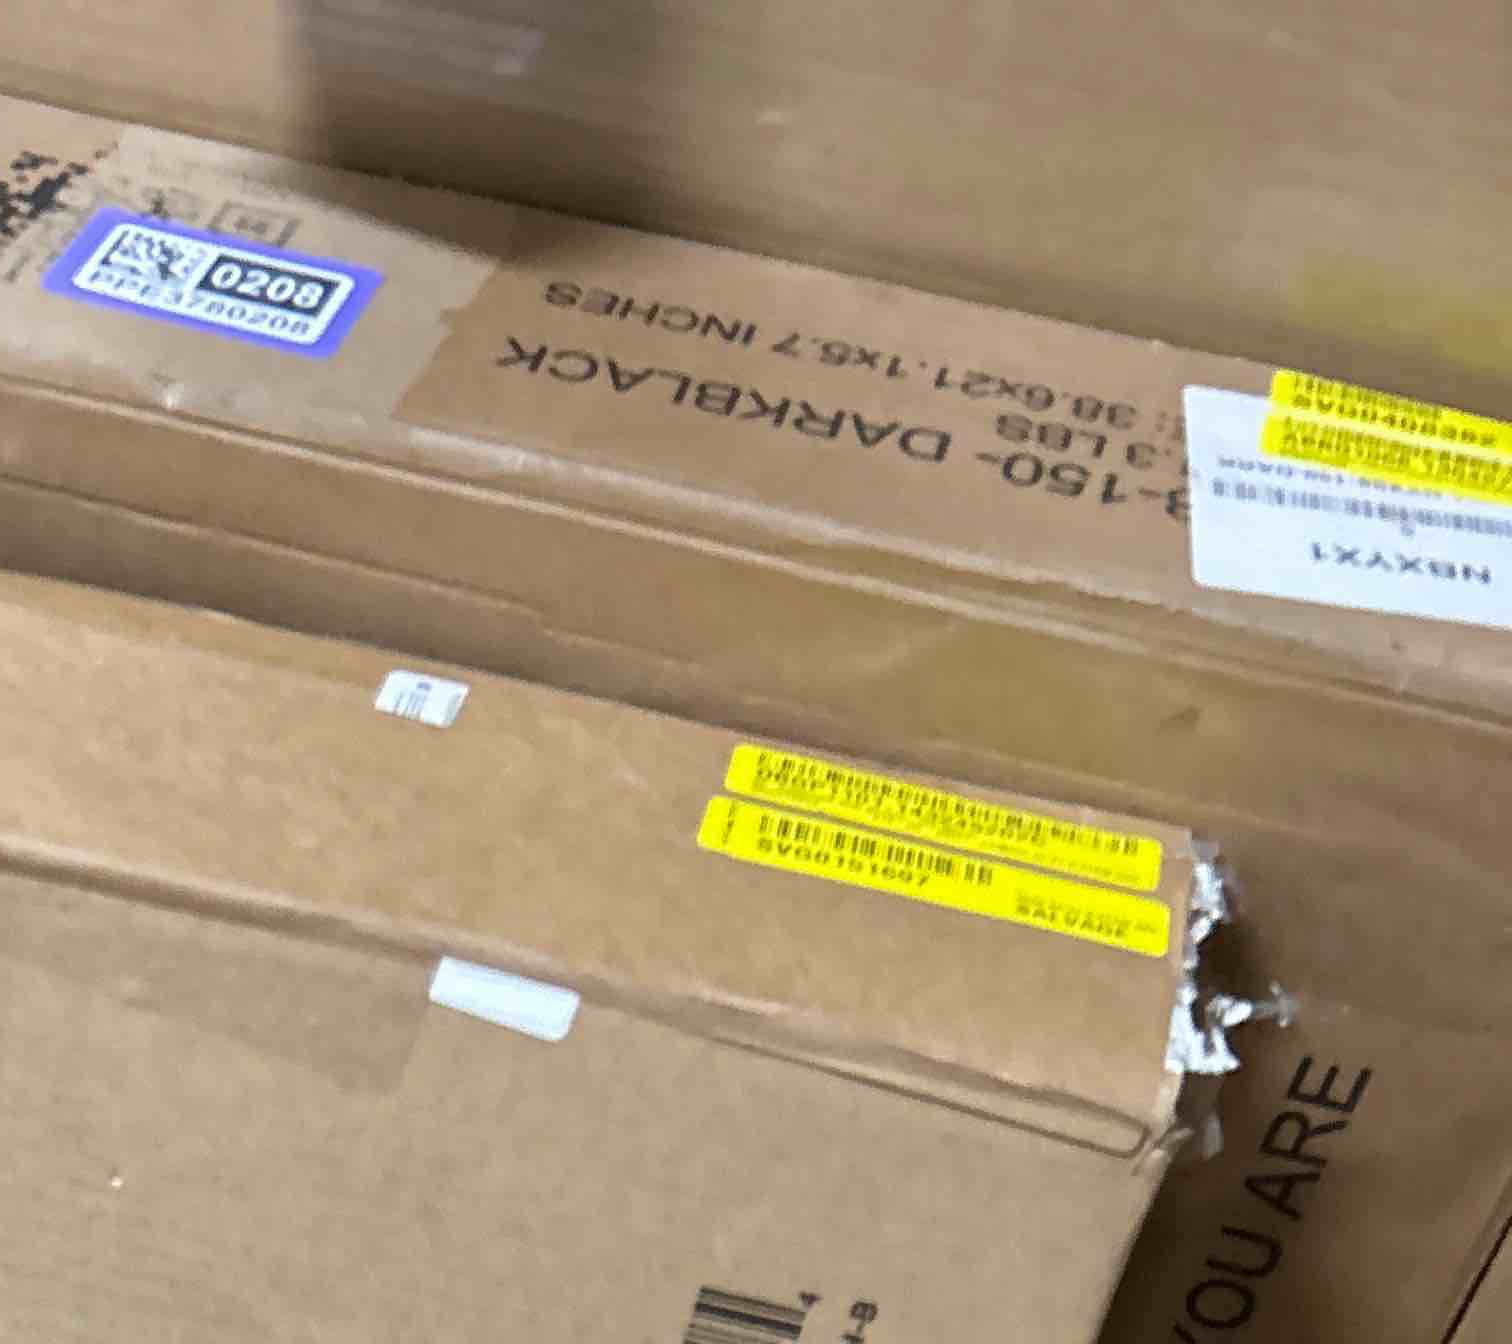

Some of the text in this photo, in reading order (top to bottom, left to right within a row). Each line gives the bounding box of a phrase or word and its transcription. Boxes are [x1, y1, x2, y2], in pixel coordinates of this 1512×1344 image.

[209, 263, 325, 308] 0208
[543, 280, 757, 346] INCHES
[496, 335, 952, 463] DARKBLACK
[1260, 1055, 1372, 1227] ARE
